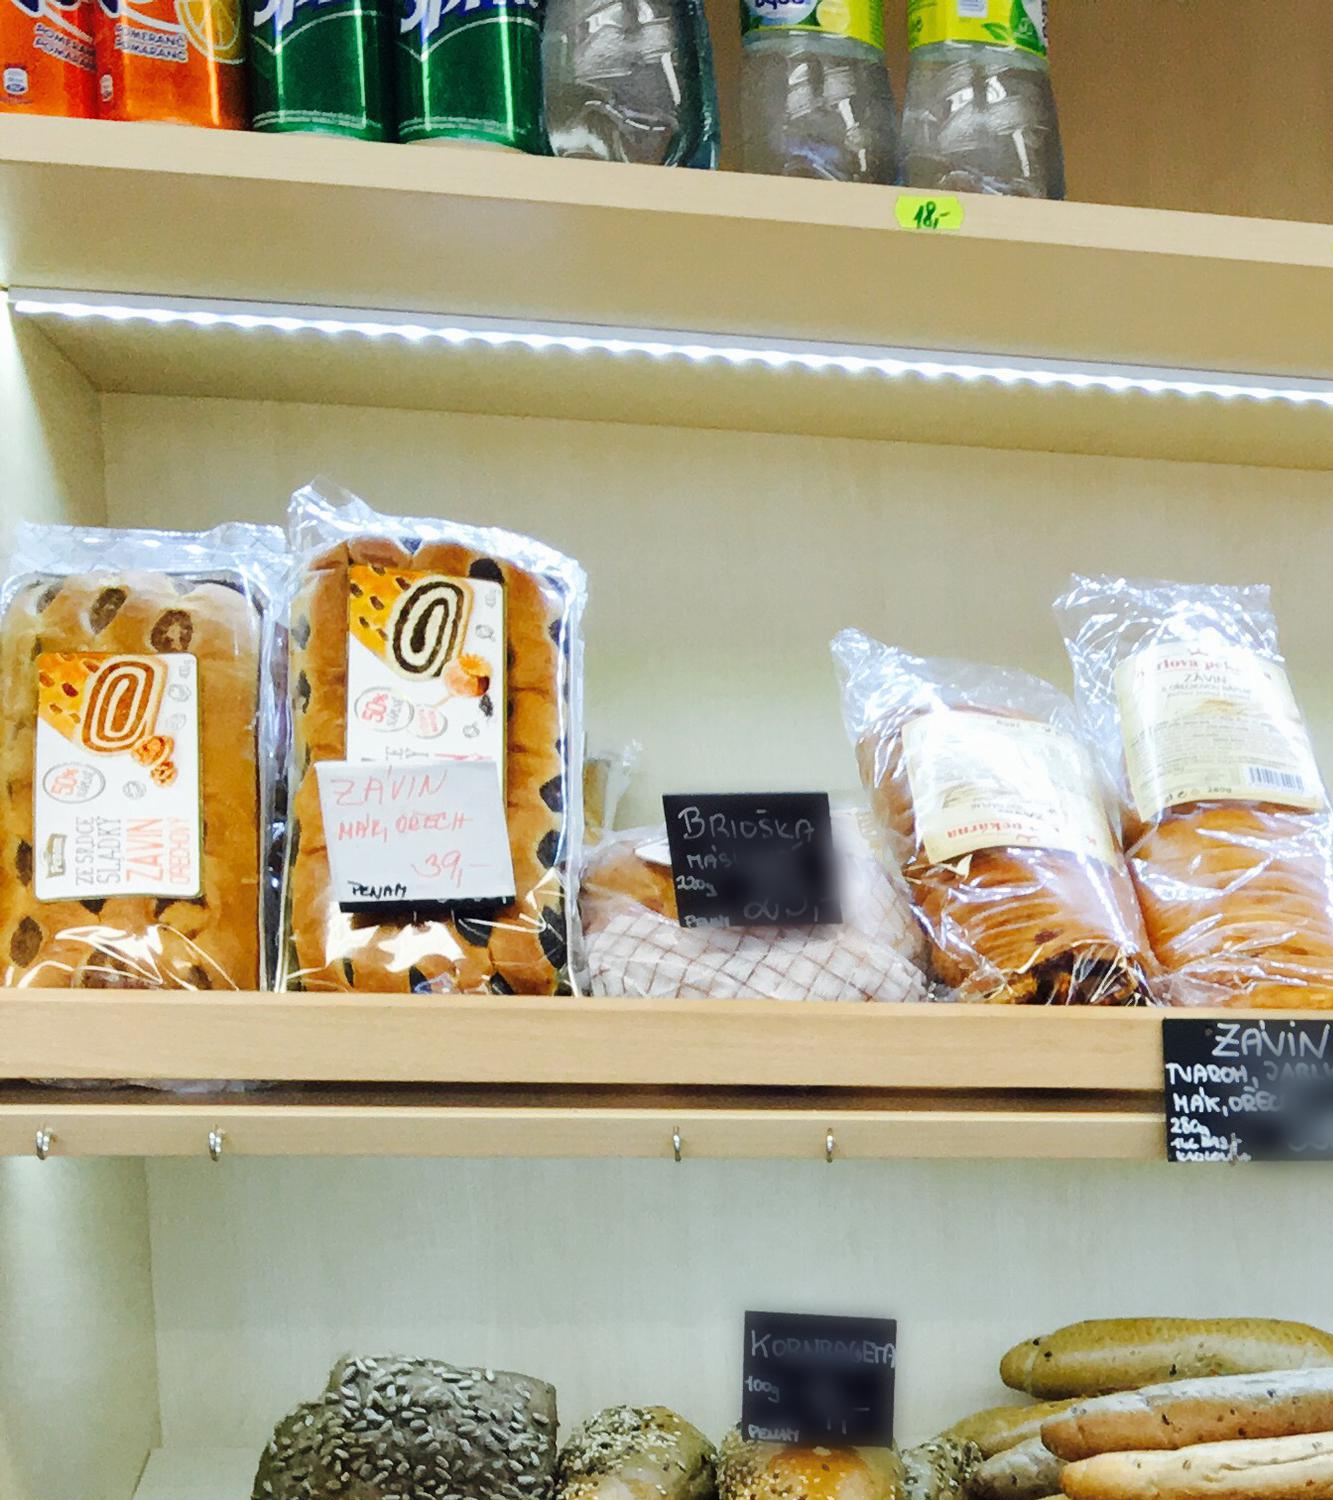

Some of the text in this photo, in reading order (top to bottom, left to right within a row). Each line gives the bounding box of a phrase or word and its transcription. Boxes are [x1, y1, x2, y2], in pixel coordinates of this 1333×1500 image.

[914, 200, 950, 229] 18,-
[330, 765, 448, 806] ZÁVIN
[676, 806, 815, 843] BRIOŠKA
[1211, 1020, 1331, 1059] ZÁVIN
